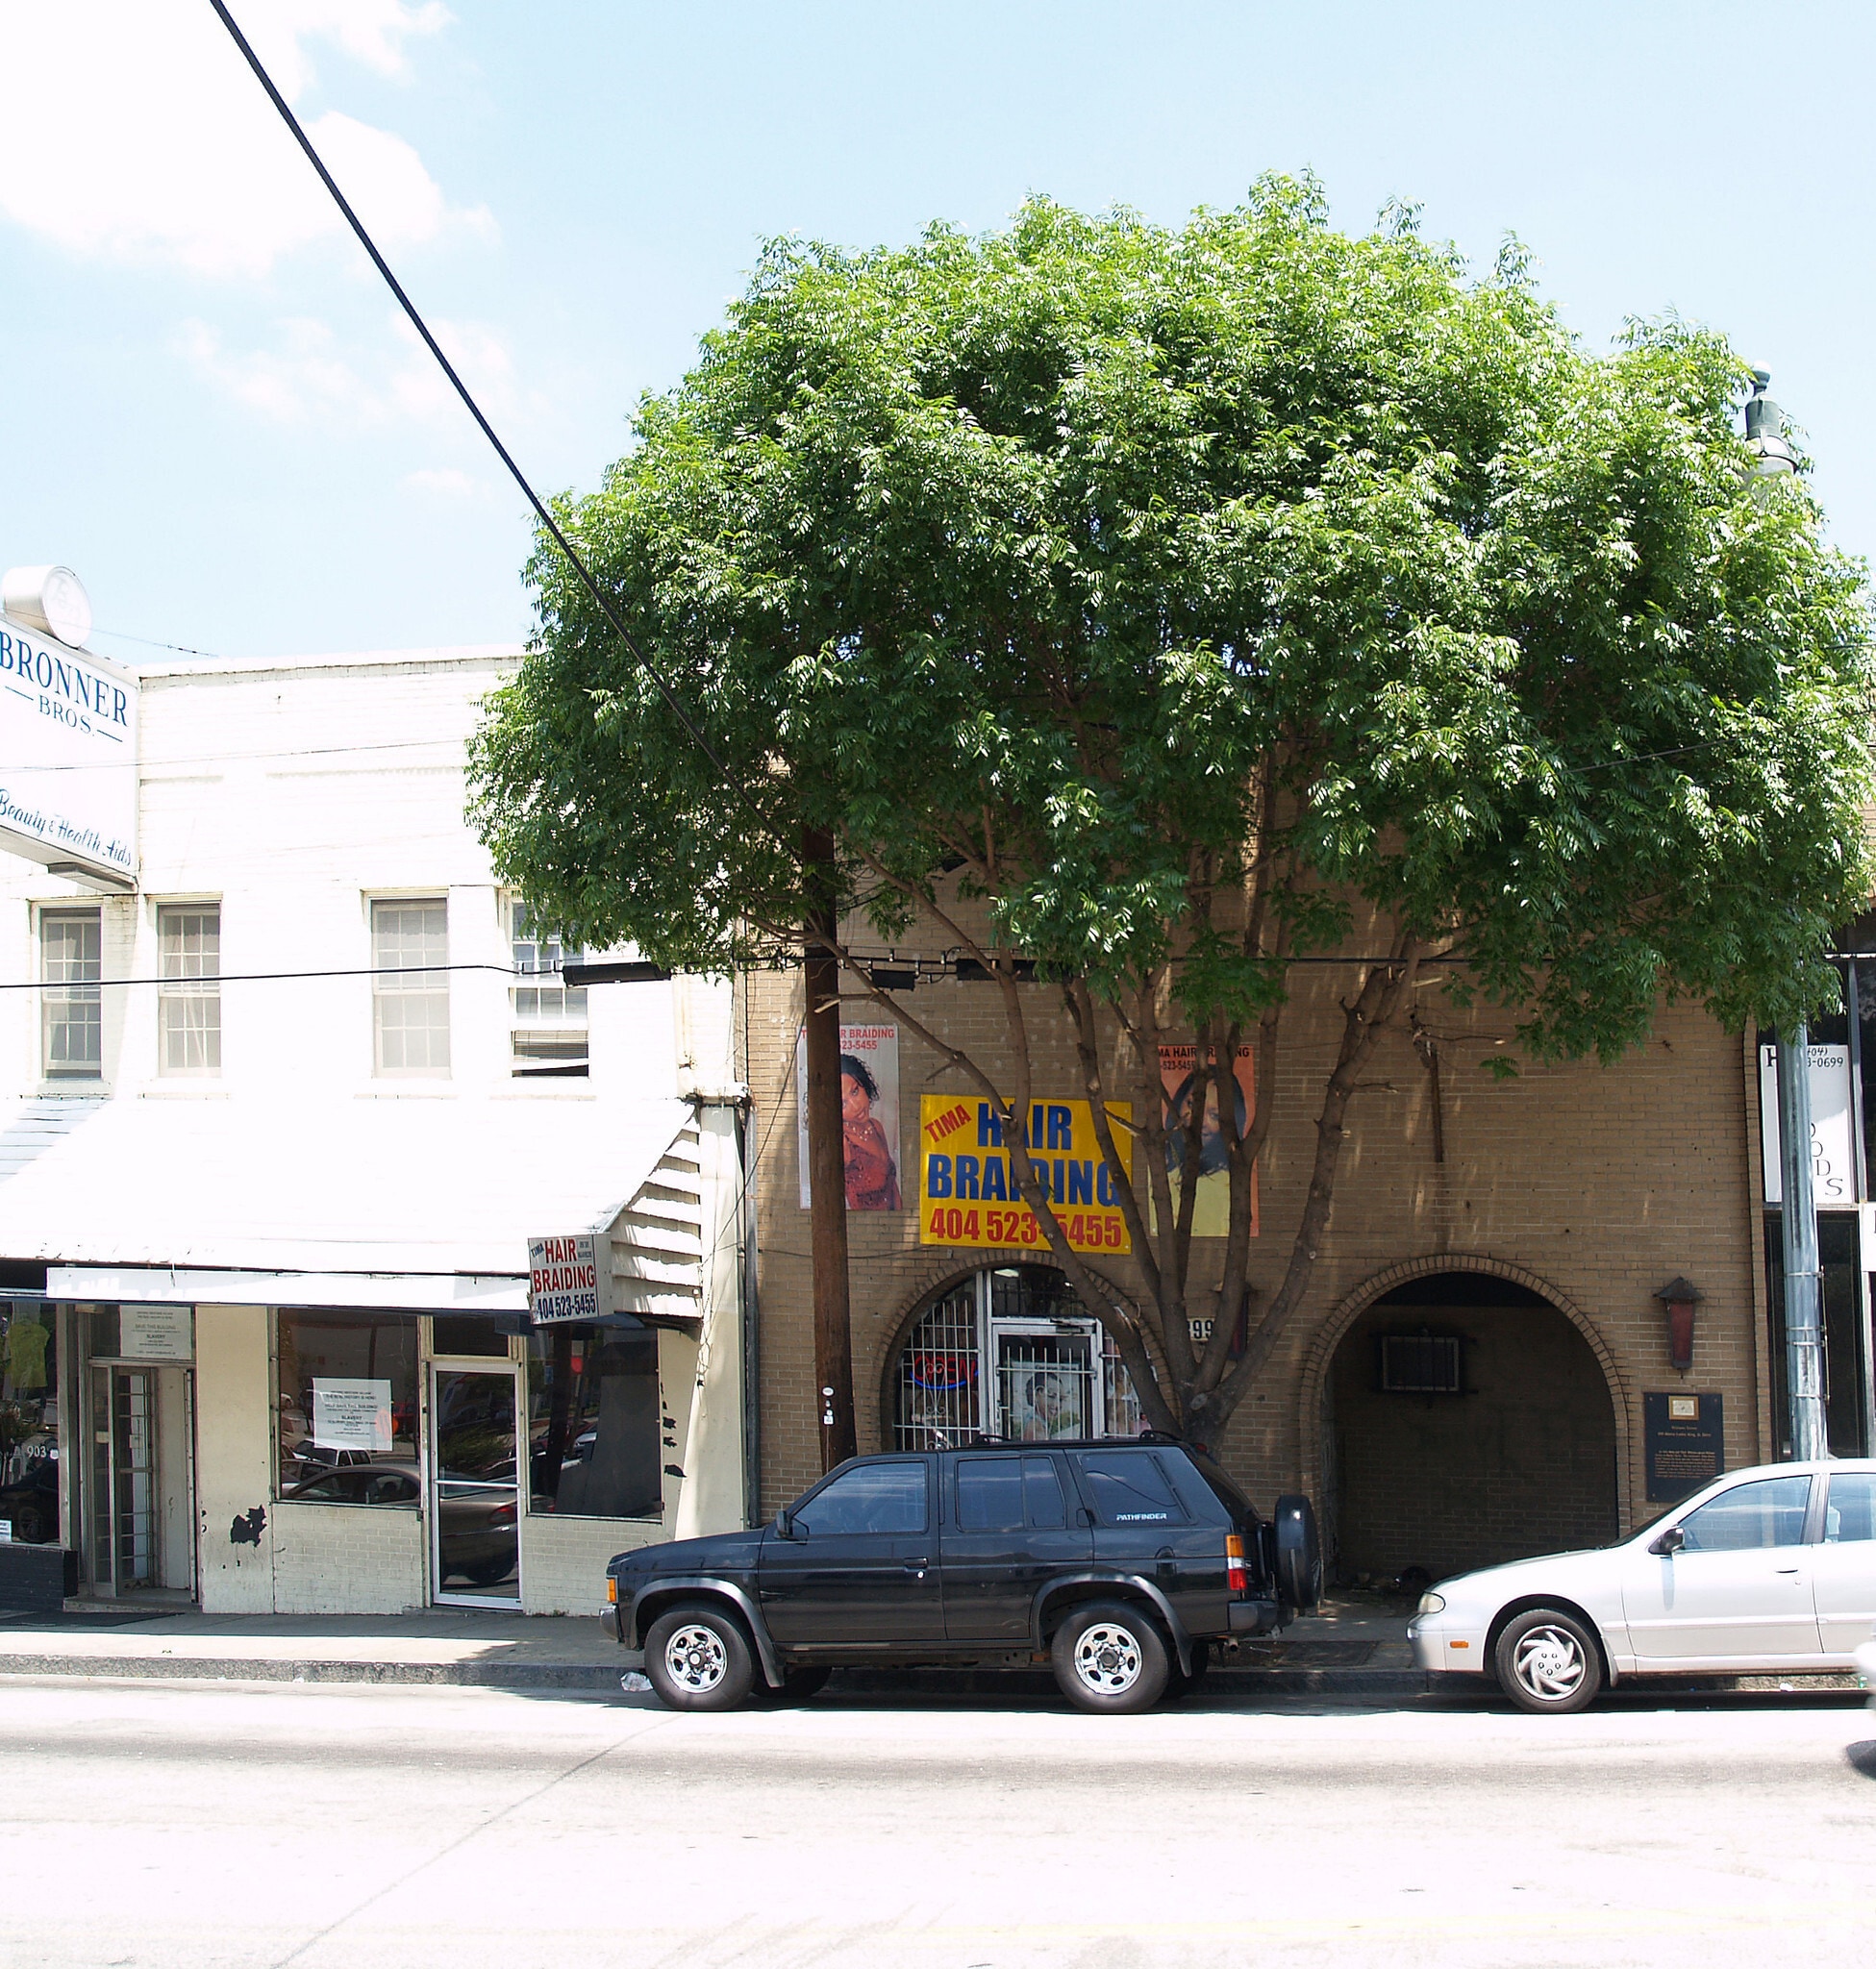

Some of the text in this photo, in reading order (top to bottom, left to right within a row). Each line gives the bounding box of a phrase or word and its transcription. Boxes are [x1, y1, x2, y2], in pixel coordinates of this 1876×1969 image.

[0, 631, 128, 727] BRONNER
[38, 694, 95, 737] BROS.
[0, 788, 46, 836] Beauty
[55, 814, 101, 852] Health
[102, 838, 132, 866] Aids
[849, 1028, 894, 1038] BRAIDING
[1173, 1047, 1196, 1058] HAIR
[924, 1104, 972, 1143] TIMA
[930, 1208, 980, 1240] 404
[531, 1243, 544, 1258] TIMA
[545, 1238, 577, 1263] HAIR
[533, 1264, 595, 1294] BRAIDING
[914, 1355, 976, 1384] OPEN
[27, 1445, 47, 1458] 903
[1116, 1512, 1167, 1521] PATHFINDER
